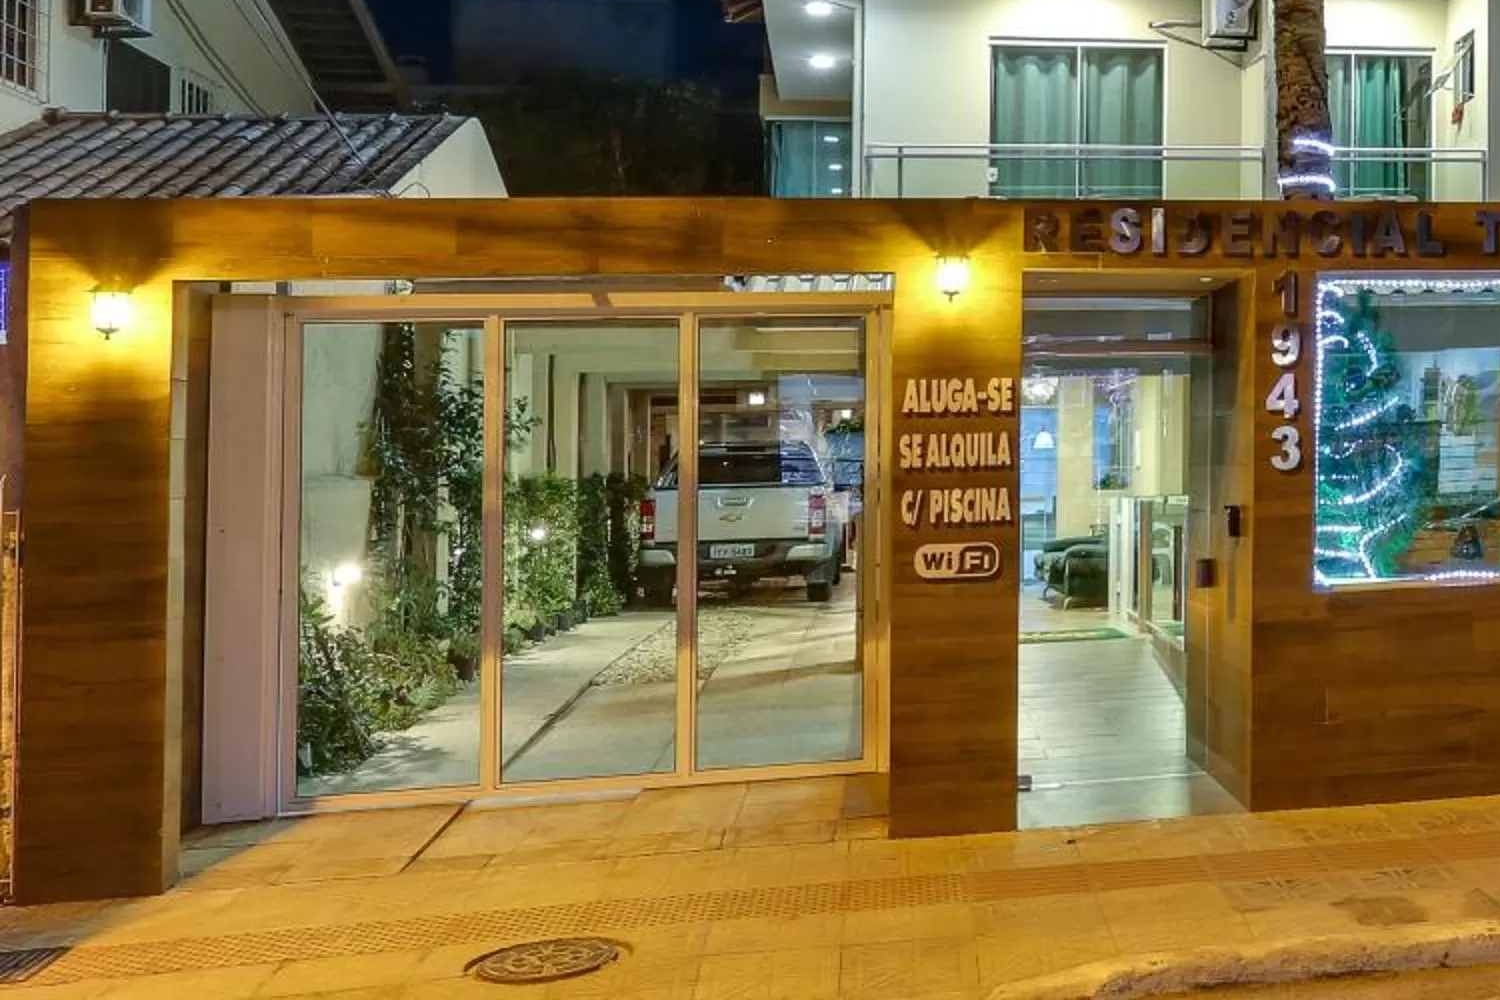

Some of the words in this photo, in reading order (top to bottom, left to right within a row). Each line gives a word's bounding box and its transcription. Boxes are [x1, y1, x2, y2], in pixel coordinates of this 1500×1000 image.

[1023, 206, 1443, 257] RESIDENCIAL
[1265, 270, 1302, 471] 1943
[901, 377, 1013, 414] ALUGA-SE
[899, 432, 923, 469] SE
[926, 431, 1011, 468] ALQUILA
[901, 489, 923, 526] C/
[929, 487, 1012, 524] PISCINA
